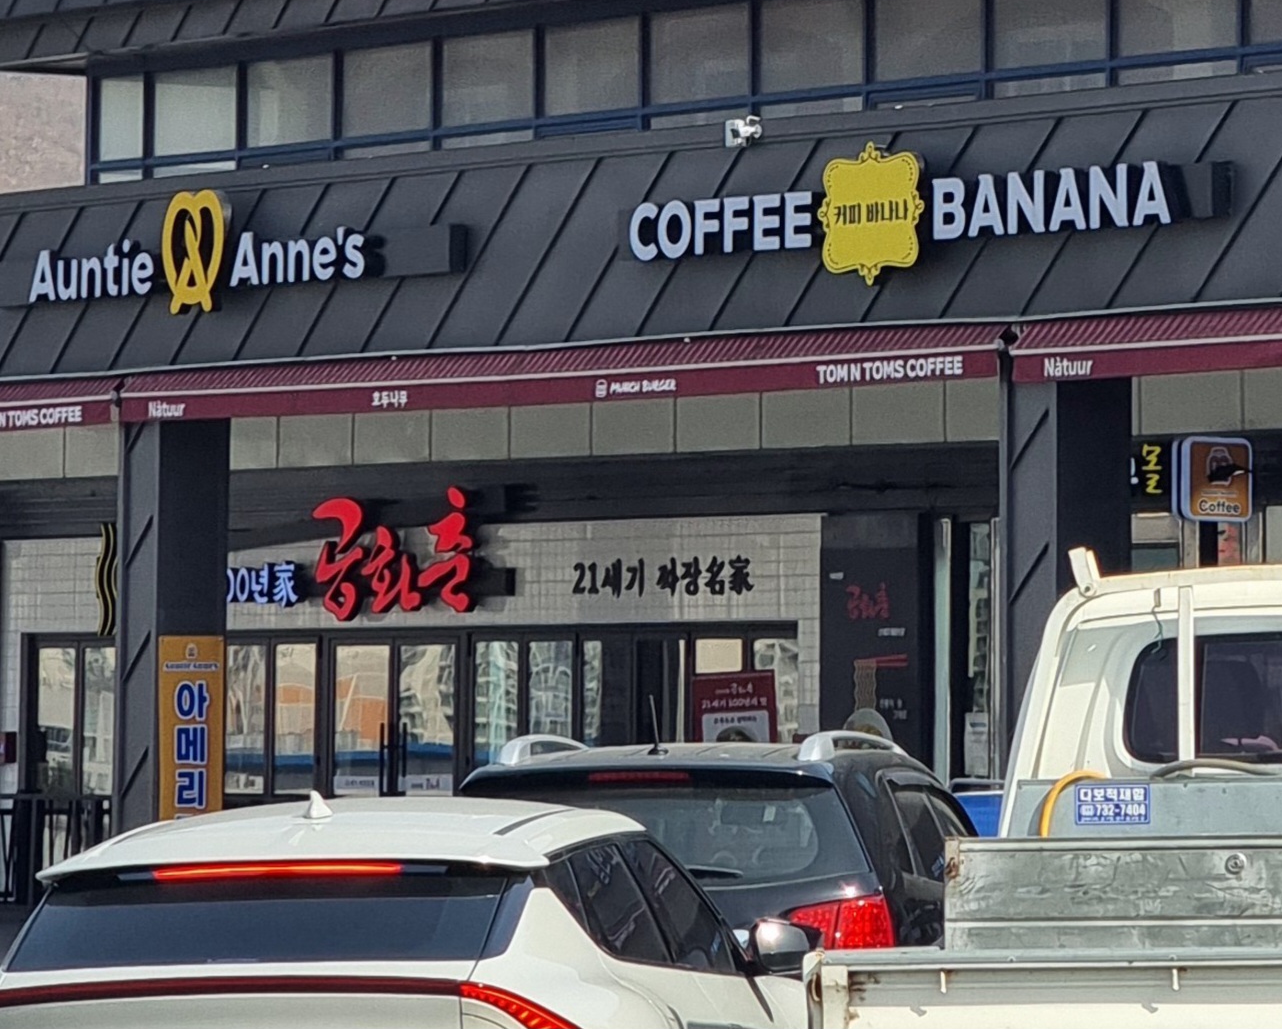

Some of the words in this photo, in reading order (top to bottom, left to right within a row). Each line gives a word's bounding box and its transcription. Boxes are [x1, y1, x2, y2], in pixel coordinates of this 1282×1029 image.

[628, 190, 812, 262] COFFEE
[931, 160, 1172, 241] BANANA
[833, 201, 862, 226] 커피
[866, 196, 909, 223] 바나나
[28, 237, 154, 303] Auntie
[229, 225, 366, 287] Anne's
[816, 363, 848, 384] TOM
[850, 362, 861, 382] N
[863, 358, 905, 381] TOMS
[906, 355, 963, 377] COFFEE
[1043, 356, 1093, 377] Nàtuur
[7, 408, 39, 428] TOMS
[40, 405, 83, 425] COFFEE
[148, 400, 186, 418] Nàtuur
[1198, 499, 1241, 515] Coffee
[572, 557, 645, 599] 21세기
[175, 681, 208, 819] 아메리
